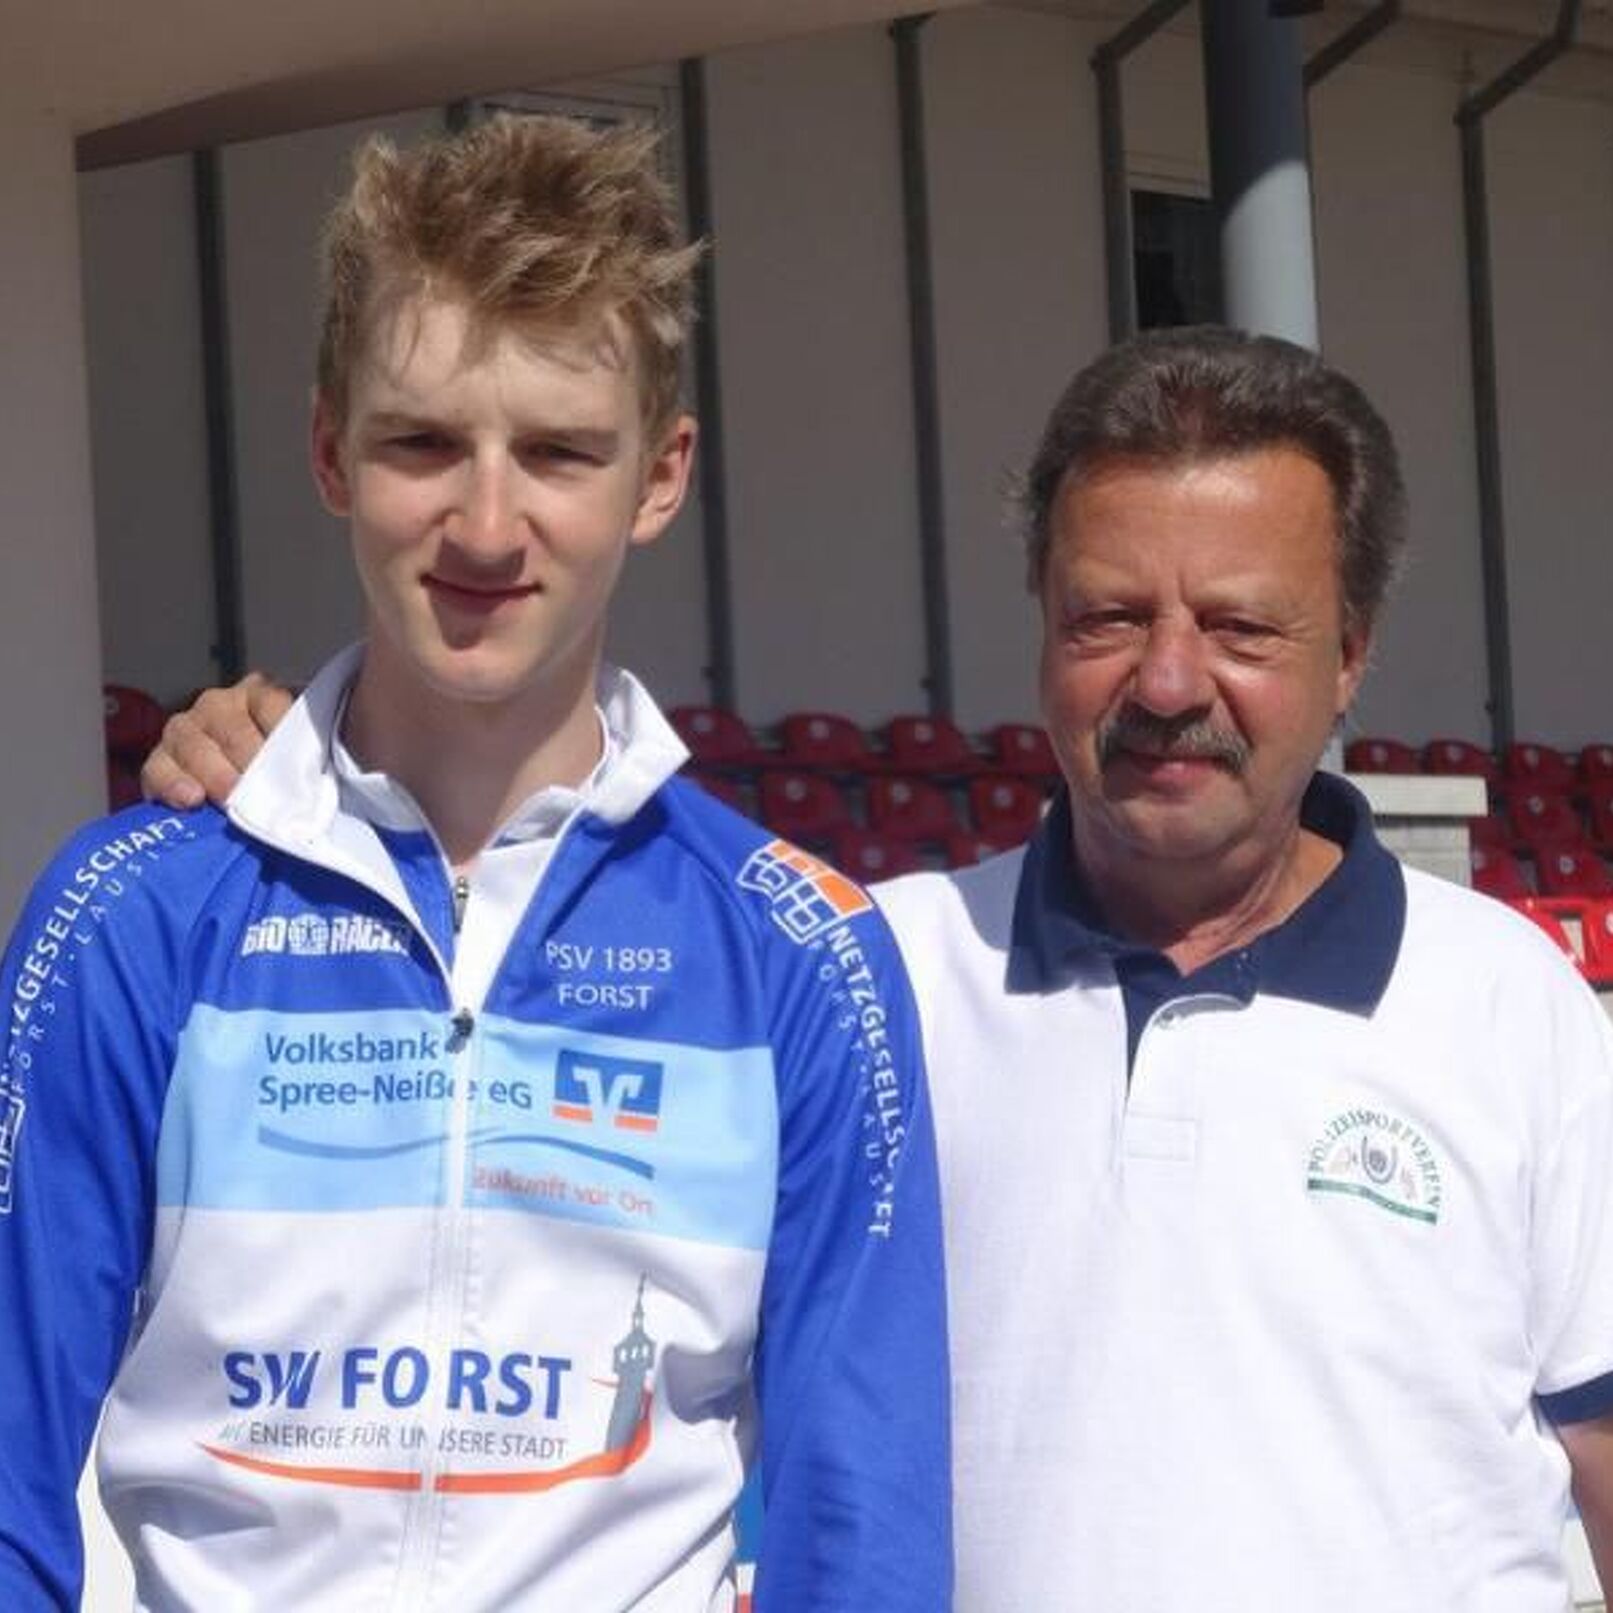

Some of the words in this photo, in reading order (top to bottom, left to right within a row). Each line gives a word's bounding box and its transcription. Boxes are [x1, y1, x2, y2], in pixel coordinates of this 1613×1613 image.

[546, 940, 593, 970] PSV
[603, 946, 672, 972] 1893
[558, 983, 653, 1010] FORST
[265, 1032, 438, 1064] Volksbank
[488, 1080, 533, 1109] eG
[223, 1351, 320, 1410] SW
[249, 1421, 346, 1449] ENERGIE
[352, 1422, 392, 1448] FÜR
[501, 1434, 567, 1459] STADT
